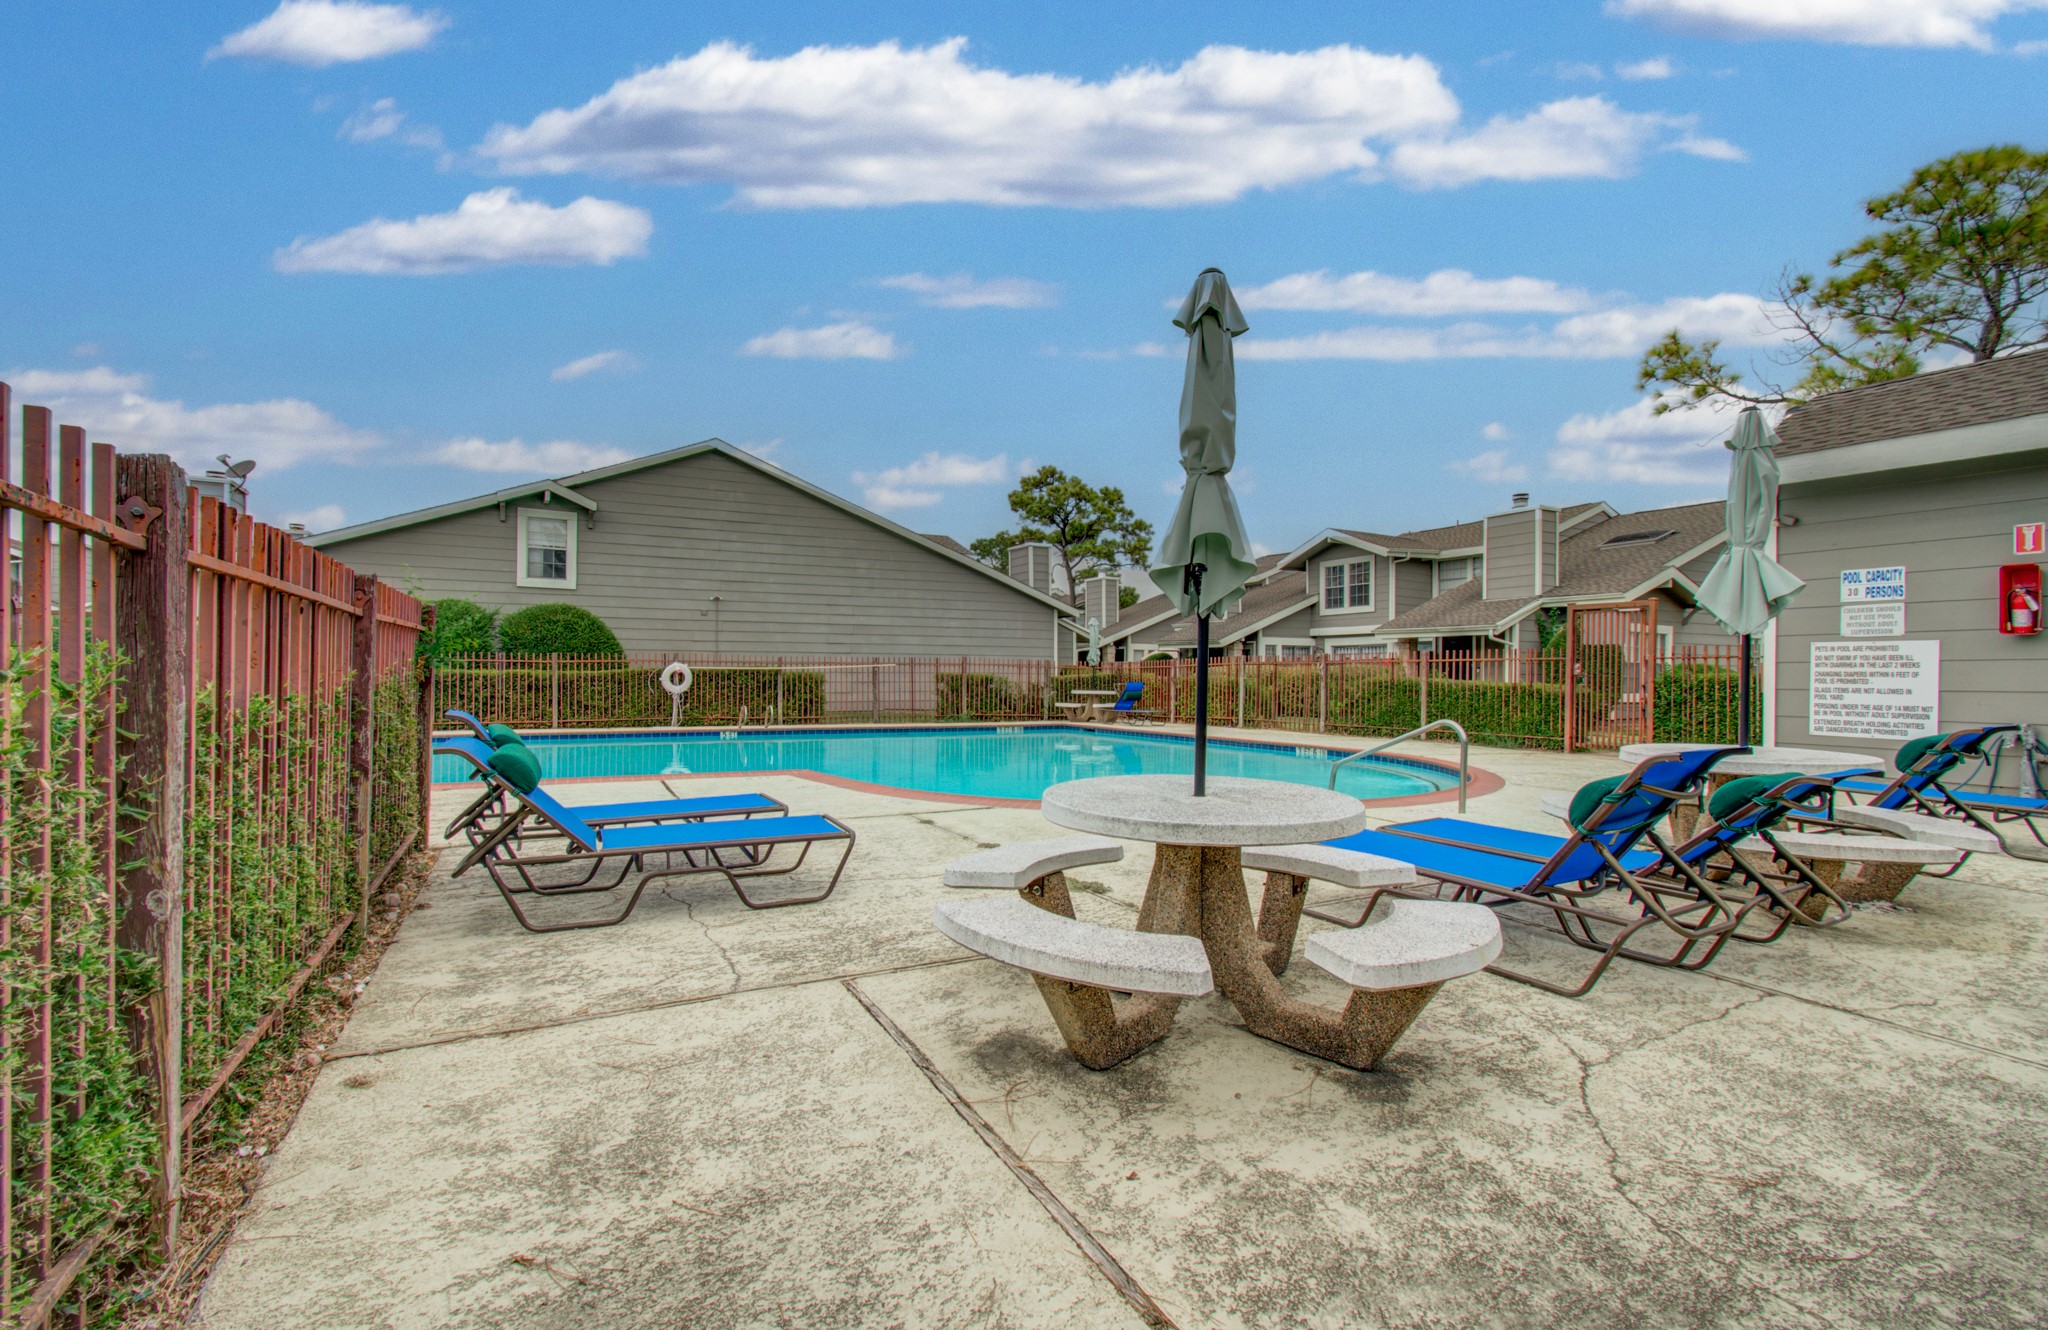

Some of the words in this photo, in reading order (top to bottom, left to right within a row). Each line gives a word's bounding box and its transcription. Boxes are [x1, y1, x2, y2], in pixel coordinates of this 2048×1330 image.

[1842, 572, 1862, 584] POOL
[1866, 569, 1903, 582] CAPACITY
[1865, 585, 1904, 598] PERSONS
